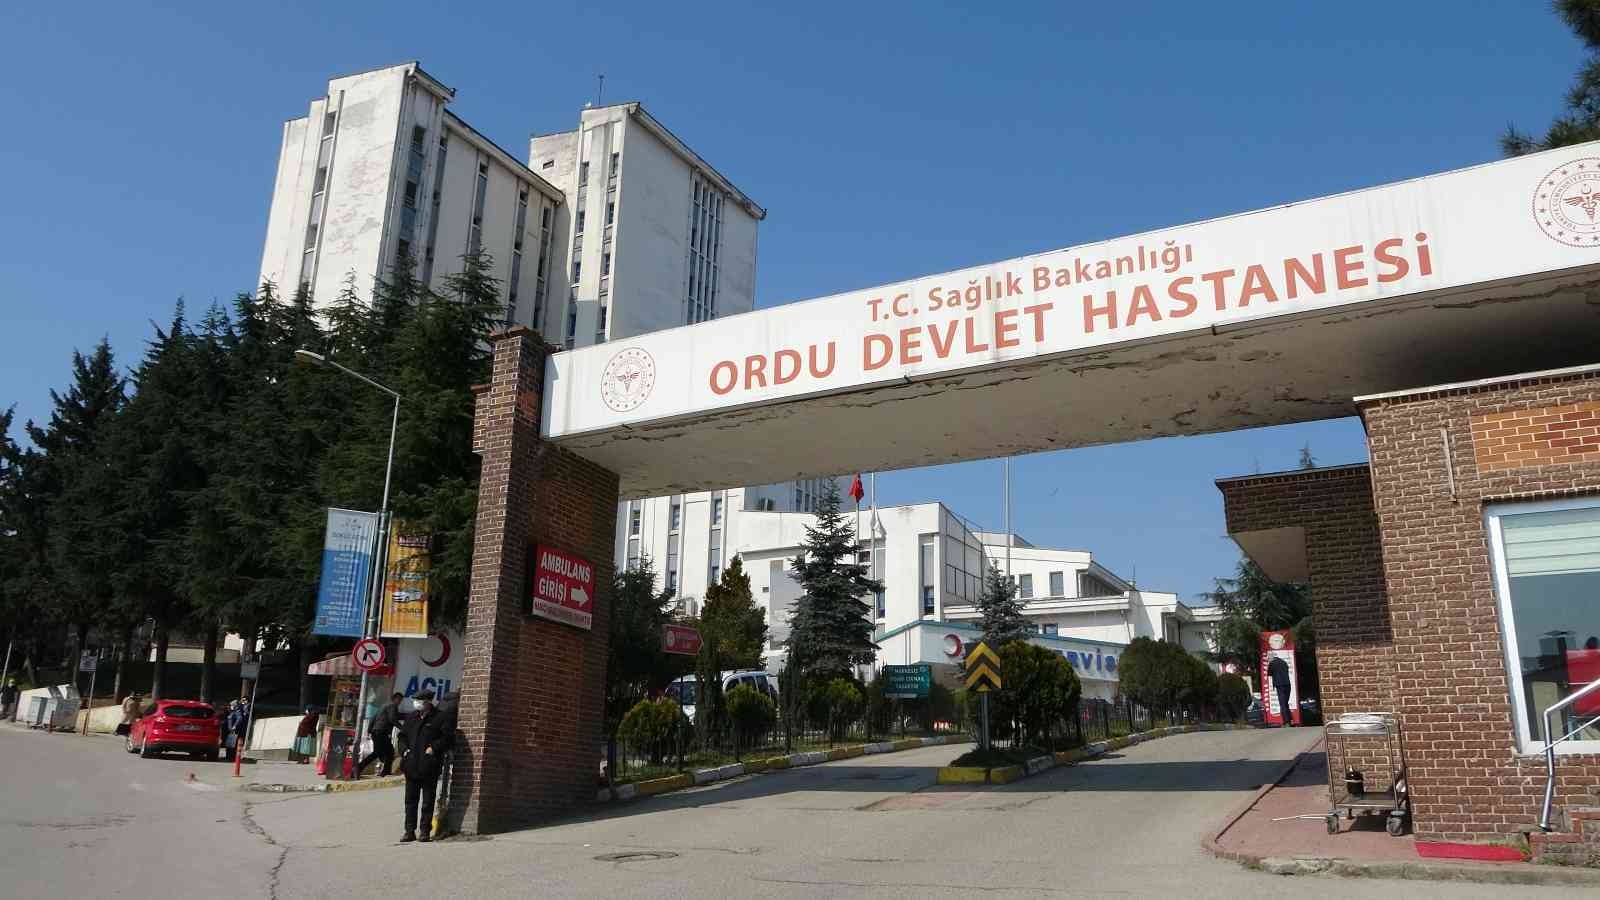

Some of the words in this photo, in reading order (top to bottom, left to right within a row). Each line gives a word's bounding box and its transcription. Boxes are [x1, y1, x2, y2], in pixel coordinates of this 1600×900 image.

[868, 293, 919, 321] T.C.
[928, 272, 1023, 310] Sağlık
[1032, 242, 1193, 292] Bakanlığı
[708, 341, 837, 396] ORDU
[863, 302, 1055, 371] DEVLET
[539, 576, 567, 601] GİRİŞİ
[541, 552, 591, 583] AMBULANS
